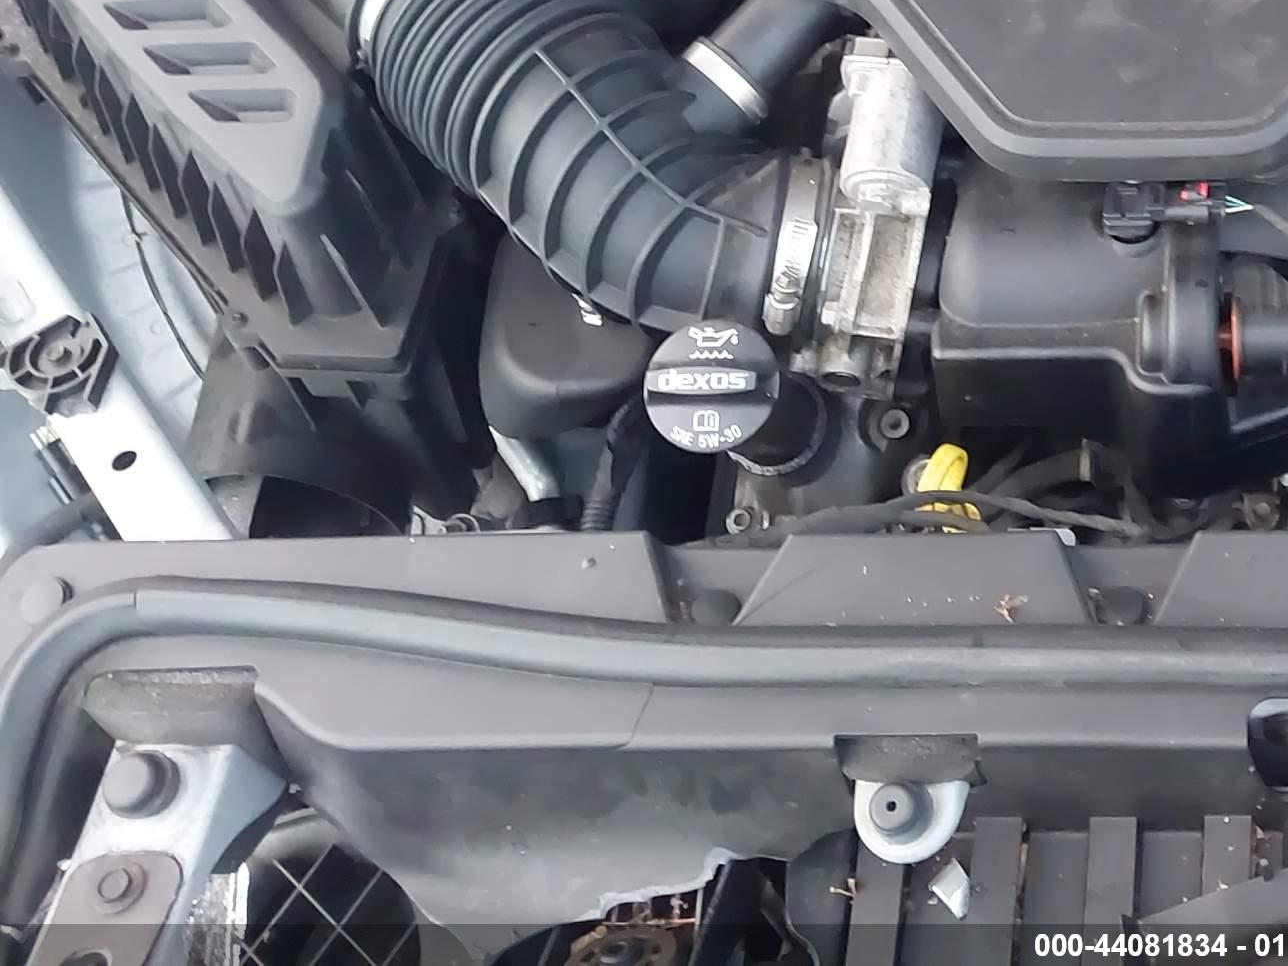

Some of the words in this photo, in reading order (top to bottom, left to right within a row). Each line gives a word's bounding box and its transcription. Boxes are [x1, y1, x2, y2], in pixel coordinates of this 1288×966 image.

[657, 369, 750, 391] dexos
[669, 425, 695, 447] SAE
[697, 424, 743, 449] 5W-30
